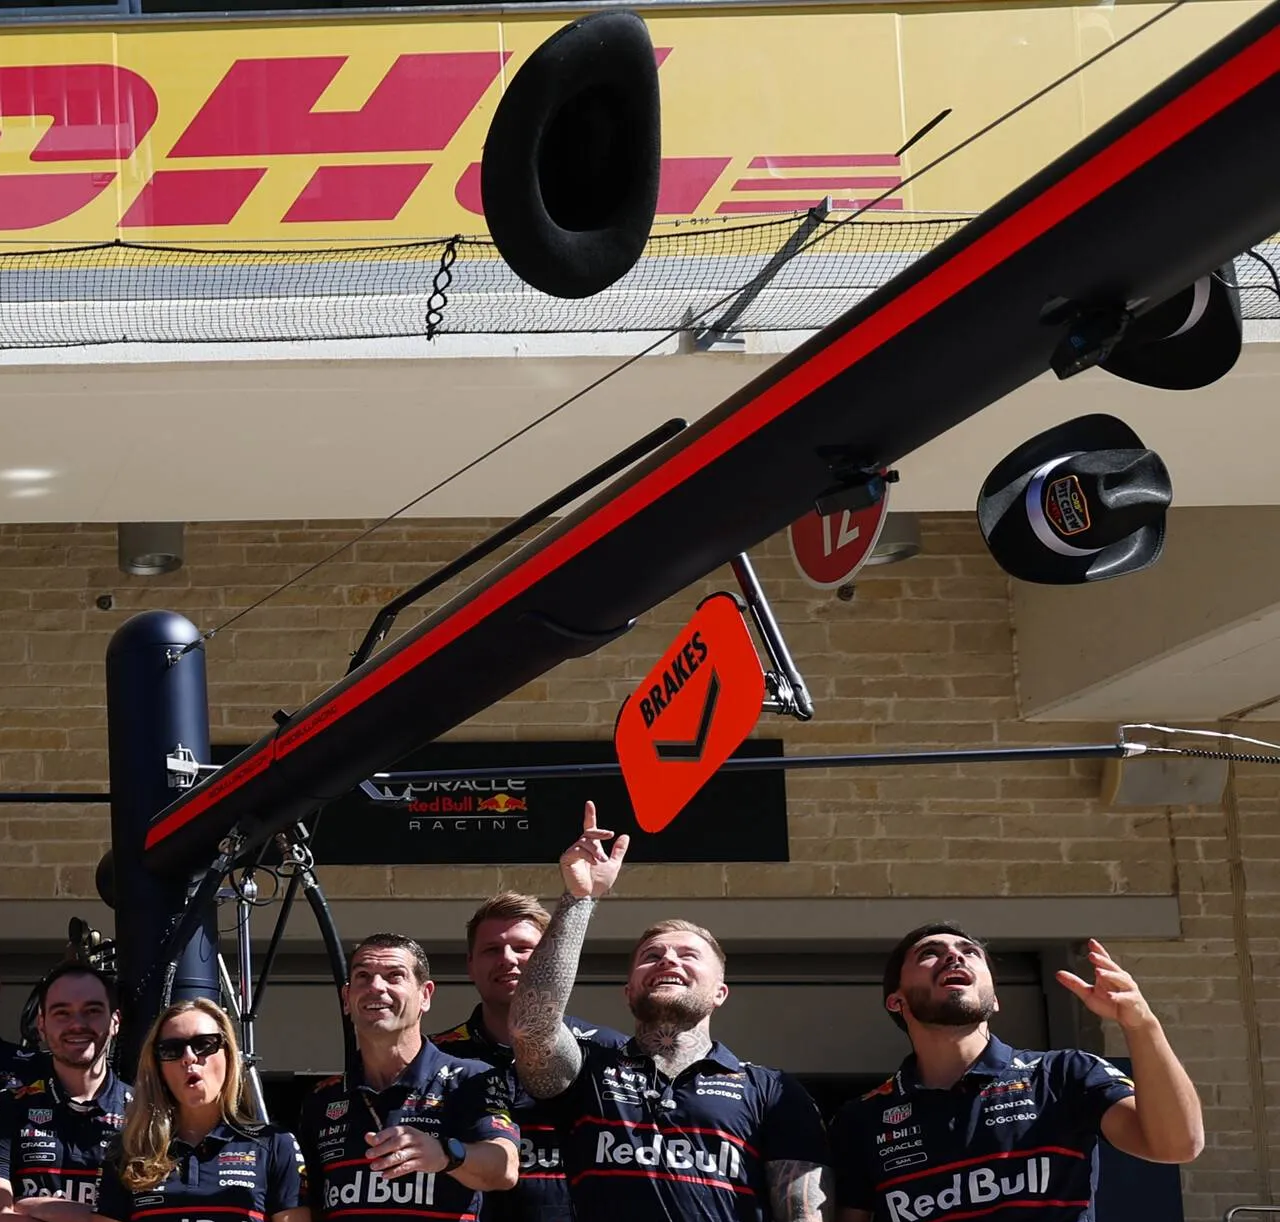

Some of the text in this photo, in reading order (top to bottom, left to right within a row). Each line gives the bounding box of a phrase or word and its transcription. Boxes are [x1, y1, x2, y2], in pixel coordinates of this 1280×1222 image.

[1061, 502, 1082, 531] CREW
[639, 630, 708, 730] BRAKES
[408, 779, 527, 791] ORACLE
[409, 820, 529, 830] RACING
[602, 1078, 644, 1092] ORACLE
[698, 1080, 745, 1089] HONDA
[706, 1089, 742, 1101] Gate.io
[887, 1103, 912, 1116] TAG
[984, 1099, 1034, 1113] HONDA
[400, 1116, 442, 1125] HONDA
[996, 1112, 1037, 1125] Gate.io
[21, 1141, 56, 1149] ORACLE
[879, 1139, 923, 1156] ORACLE
[218, 1150, 256, 1158] ORACLE
[596, 1130, 740, 1178] Red Bull
[895, 1157, 912, 1165] SAM
[218, 1169, 257, 1177] HONDA
[969, 1157, 1050, 1204] Bull
[323, 1170, 436, 1209] Red Bull
